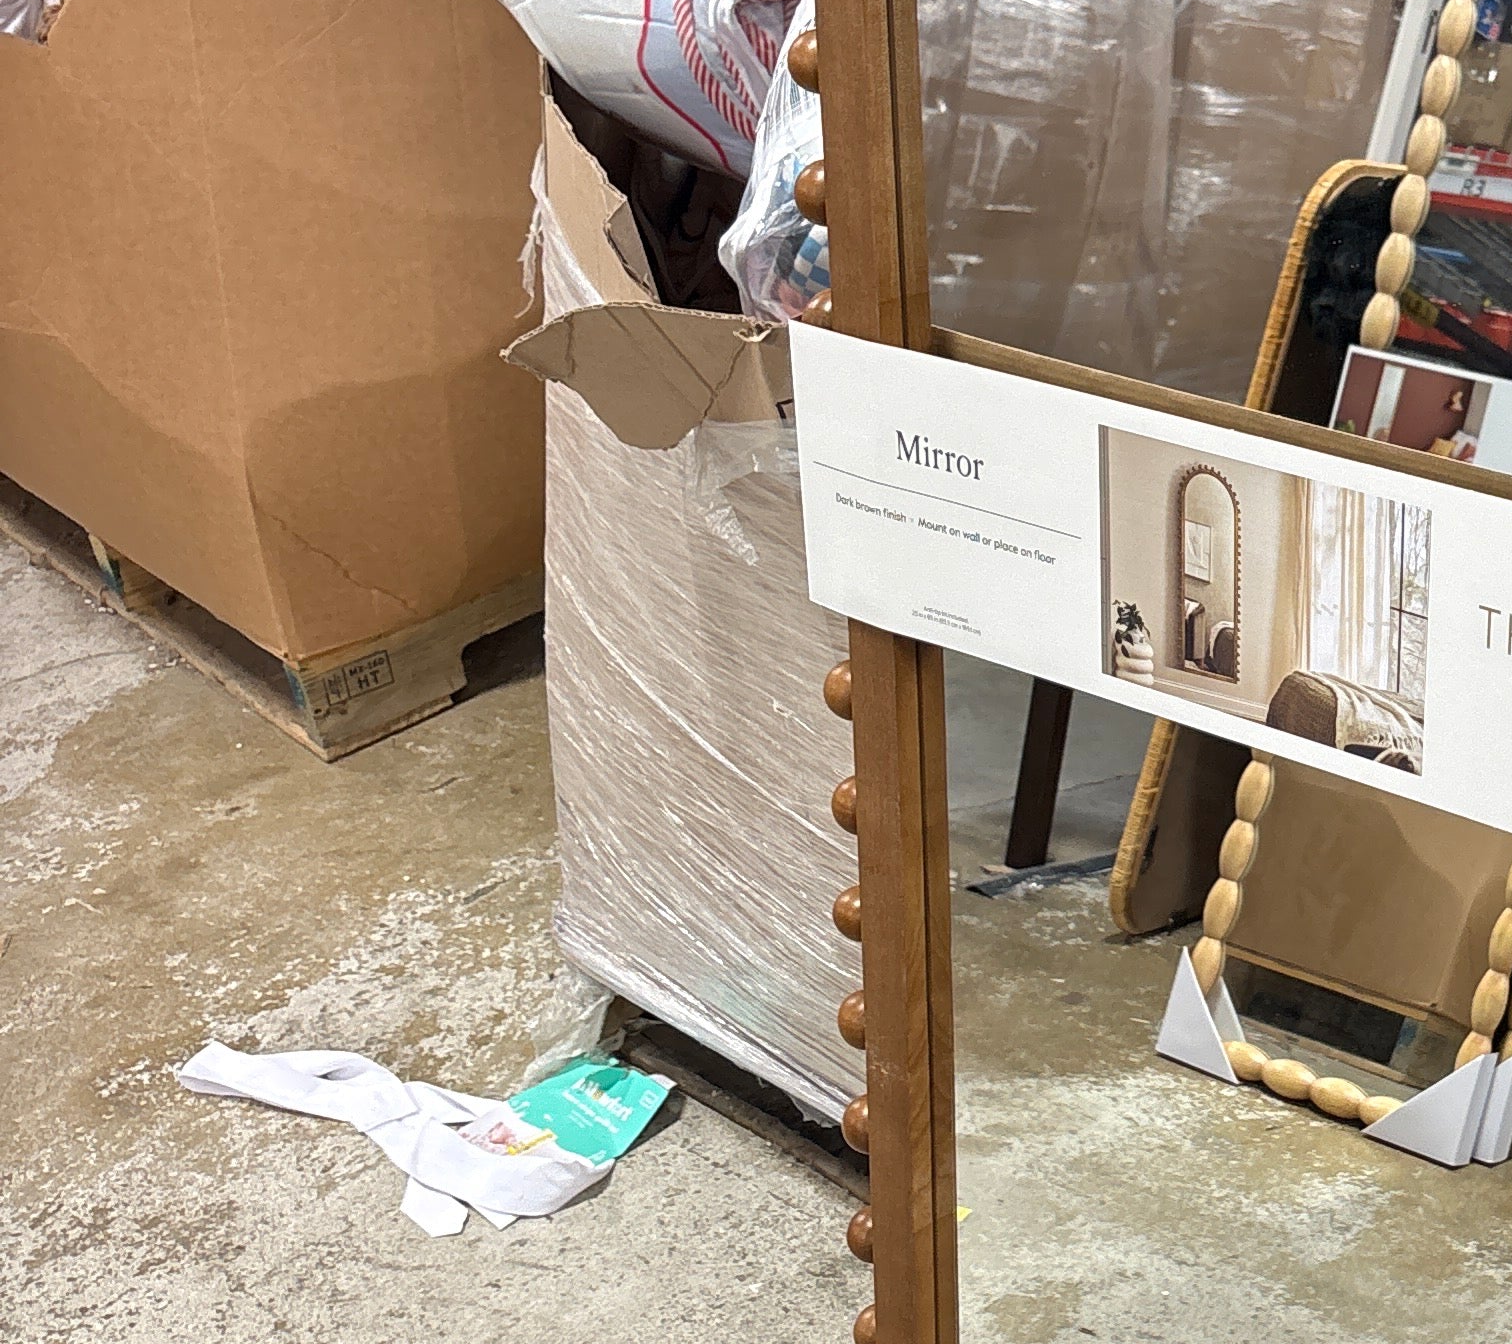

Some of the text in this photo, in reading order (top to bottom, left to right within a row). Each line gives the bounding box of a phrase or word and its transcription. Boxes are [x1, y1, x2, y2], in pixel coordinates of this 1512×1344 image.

[896, 430, 985, 481] Mirror
[835, 492, 1056, 565] Dark brown finish Mount on wall or place on floor
